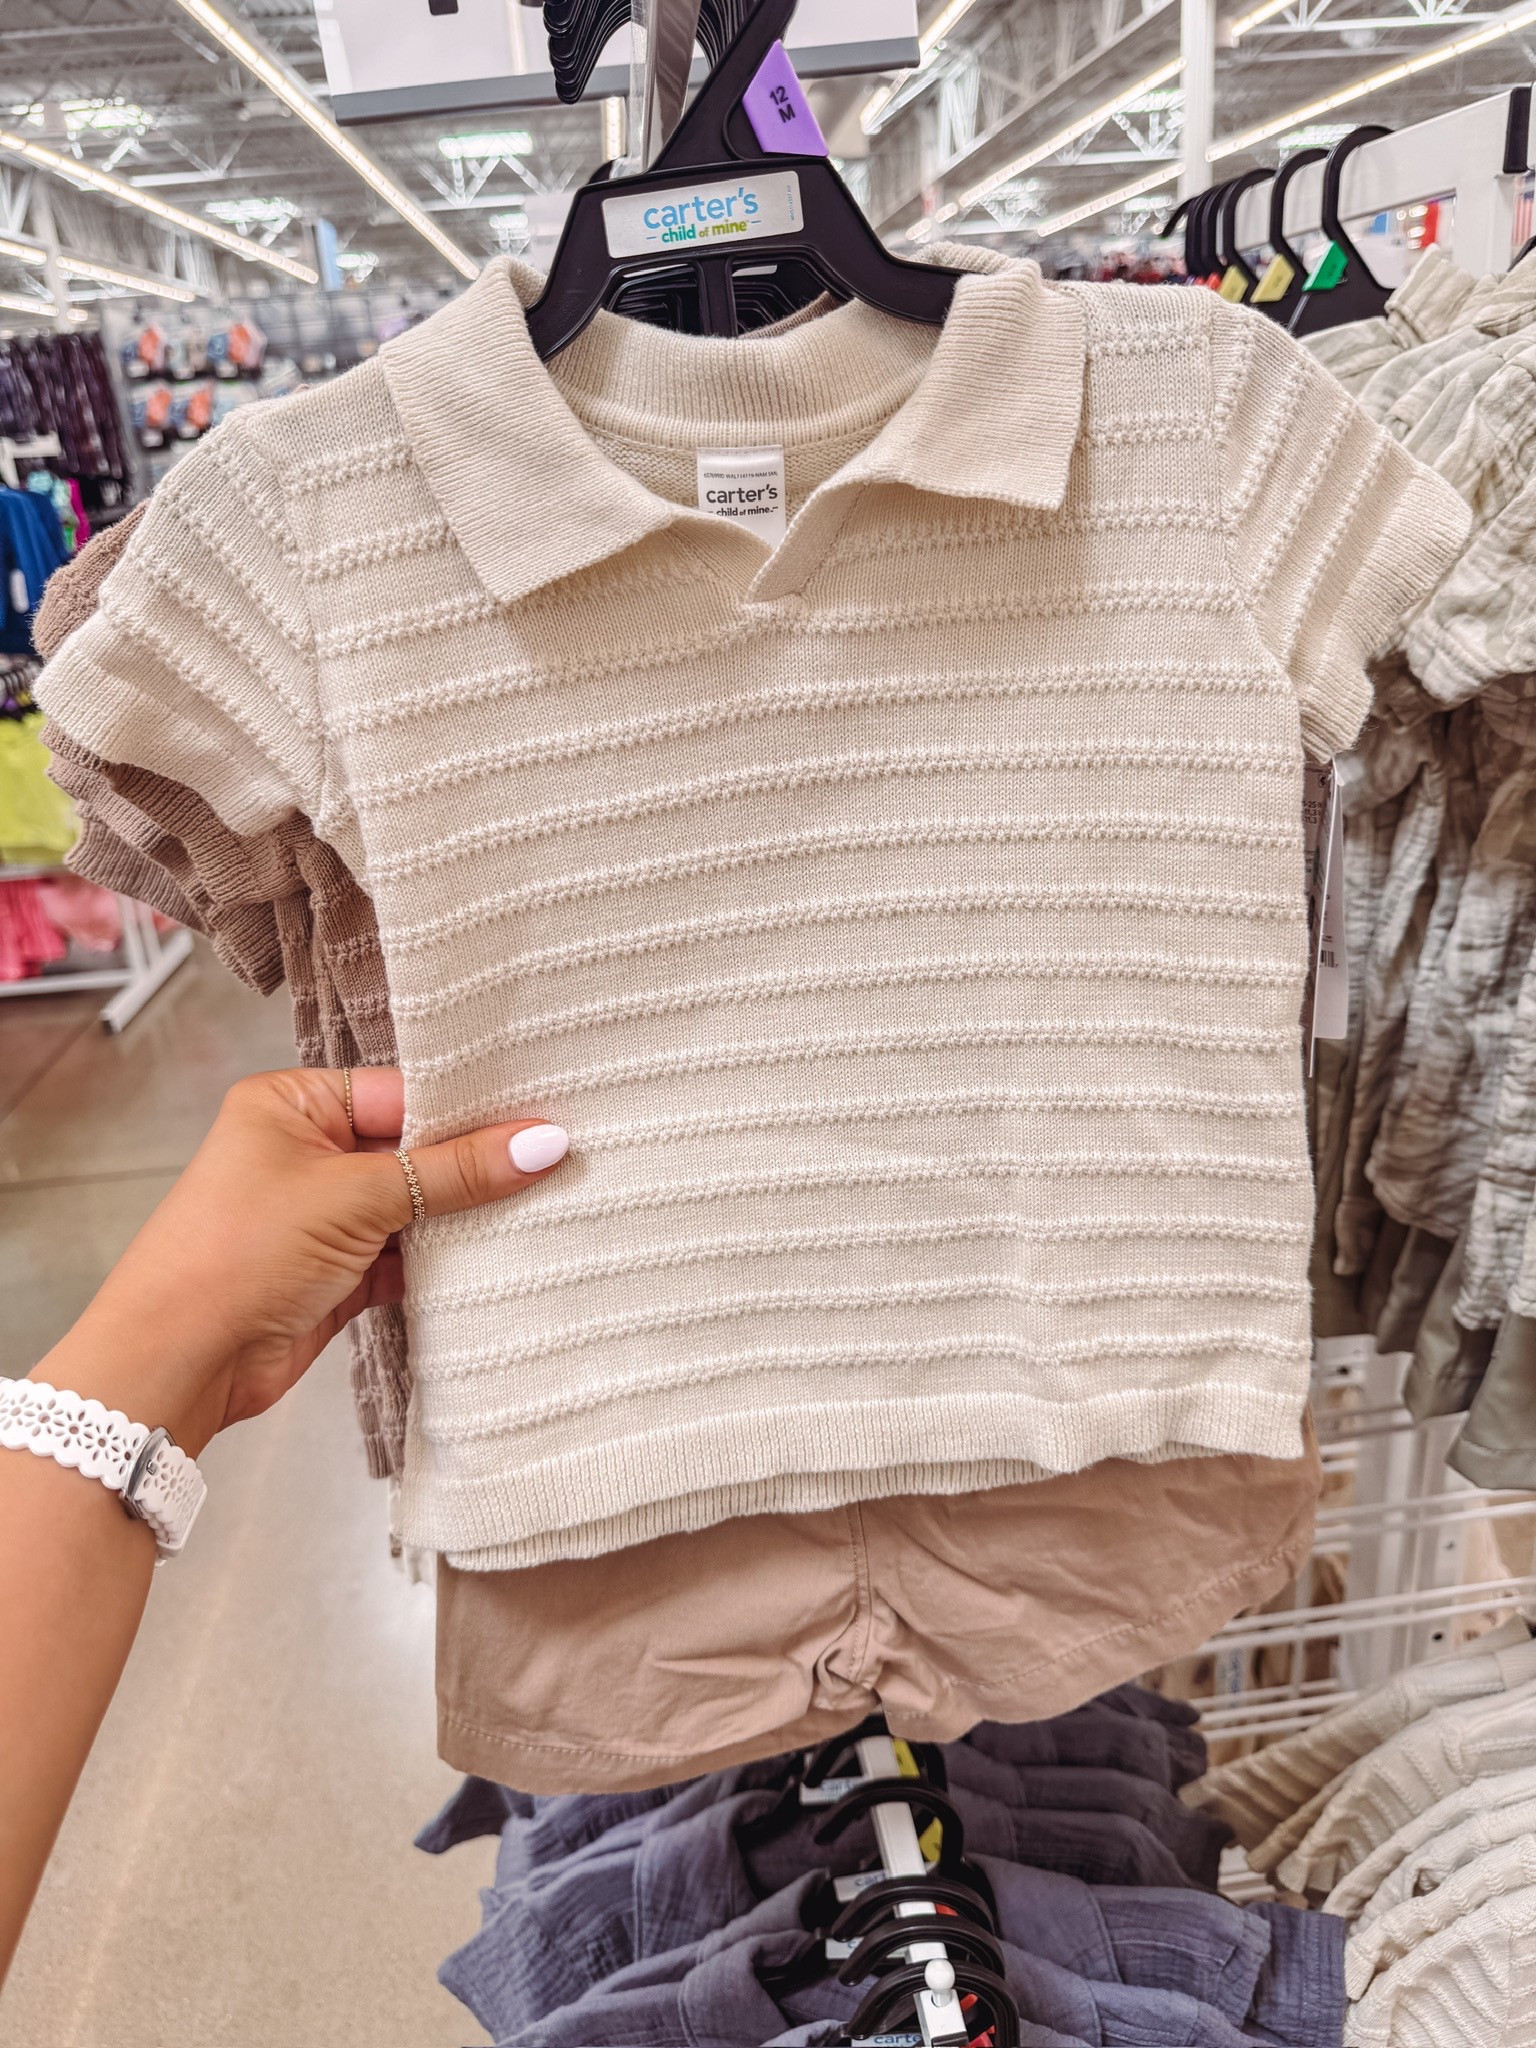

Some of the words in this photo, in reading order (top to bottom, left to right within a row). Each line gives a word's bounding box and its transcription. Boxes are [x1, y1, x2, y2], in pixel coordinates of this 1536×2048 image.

[769, 85, 790, 106] 12
[778, 103, 796, 124] M
[643, 186, 759, 230] carter's
[661, 223, 697, 243] child
[698, 226, 710, 238] of
[712, 219, 747, 236] mine
[706, 483, 778, 504] carter's
[716, 507, 738, 517] child
[873, 2033, 922, 2044] carte
